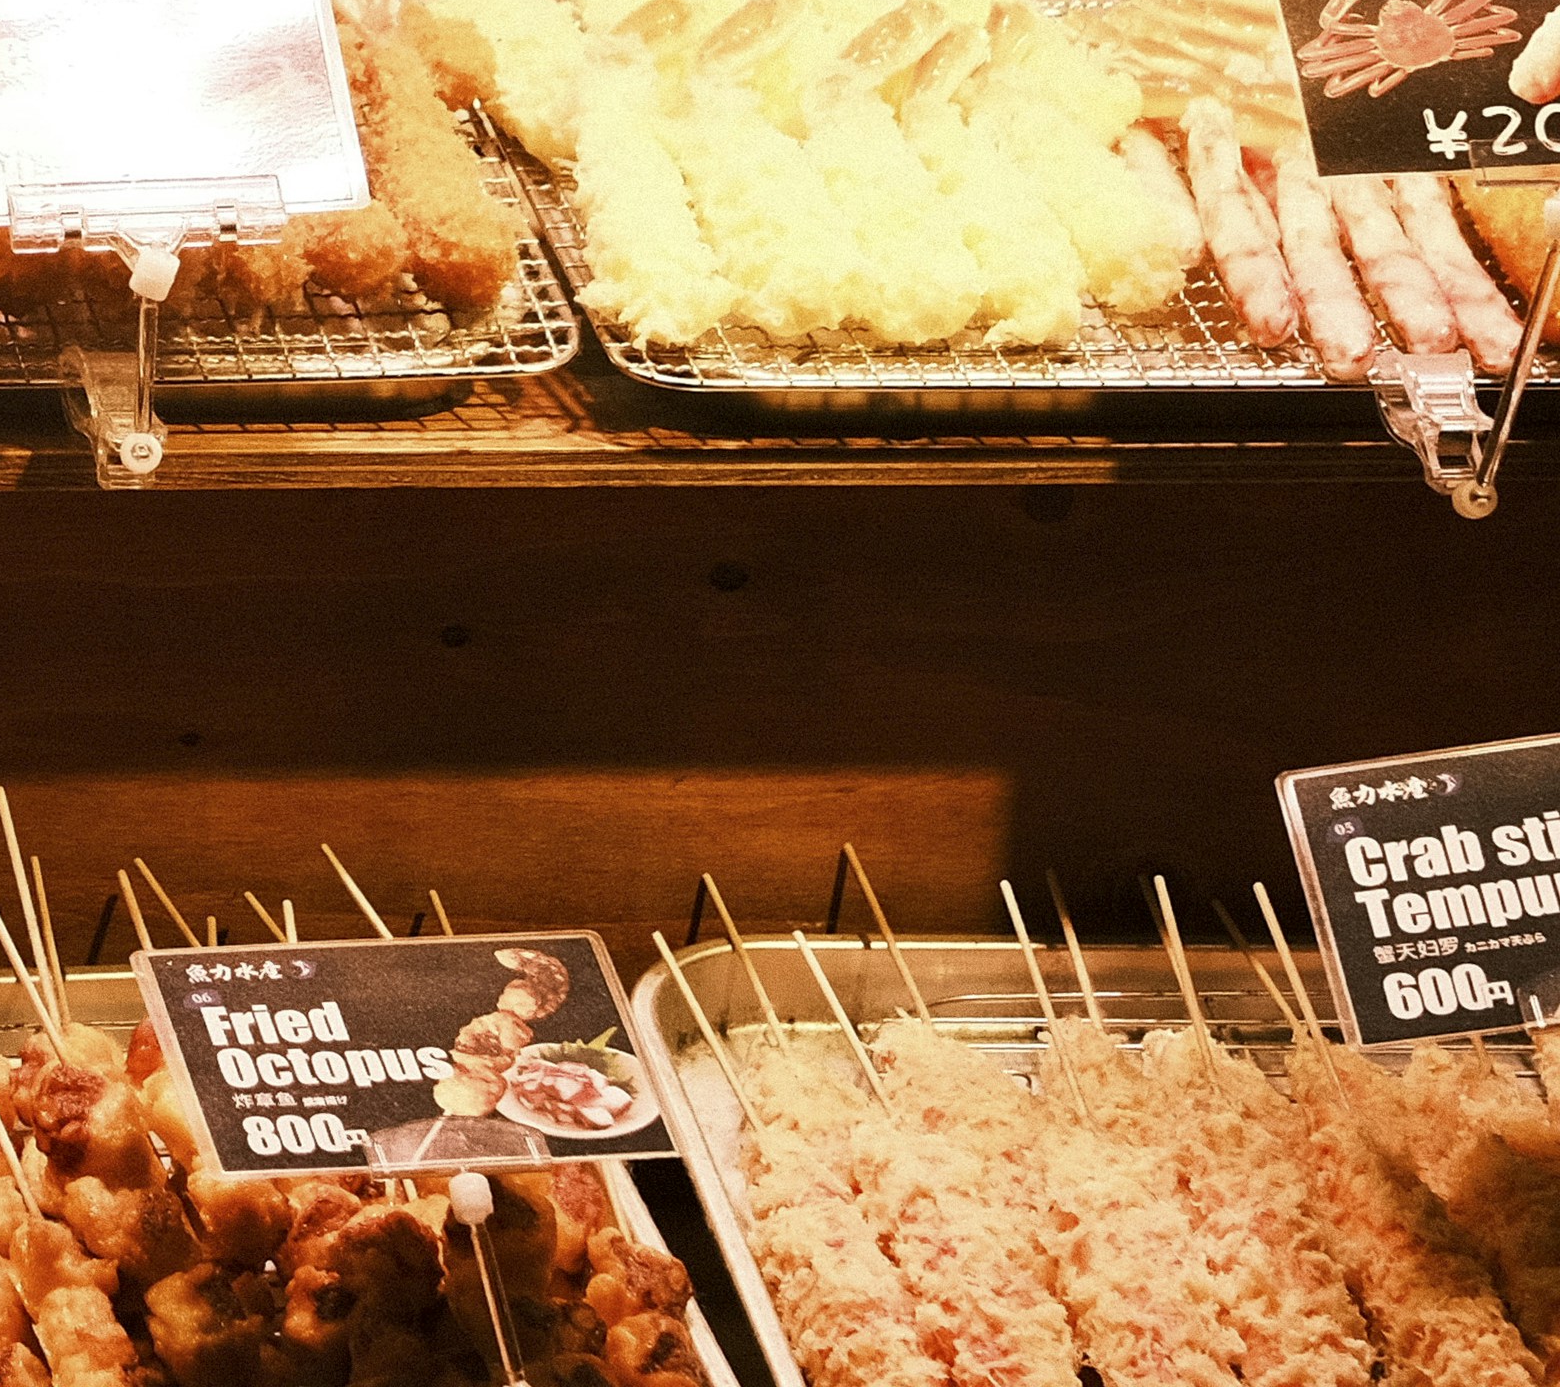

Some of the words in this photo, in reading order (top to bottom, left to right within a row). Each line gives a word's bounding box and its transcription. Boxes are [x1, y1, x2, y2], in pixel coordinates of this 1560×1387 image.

[1344, 824, 1486, 888] Crab
[1382, 962, 1515, 1021] 600円
[200, 1001, 350, 1047] Fried
[216, 1046, 454, 1090] Octopus
